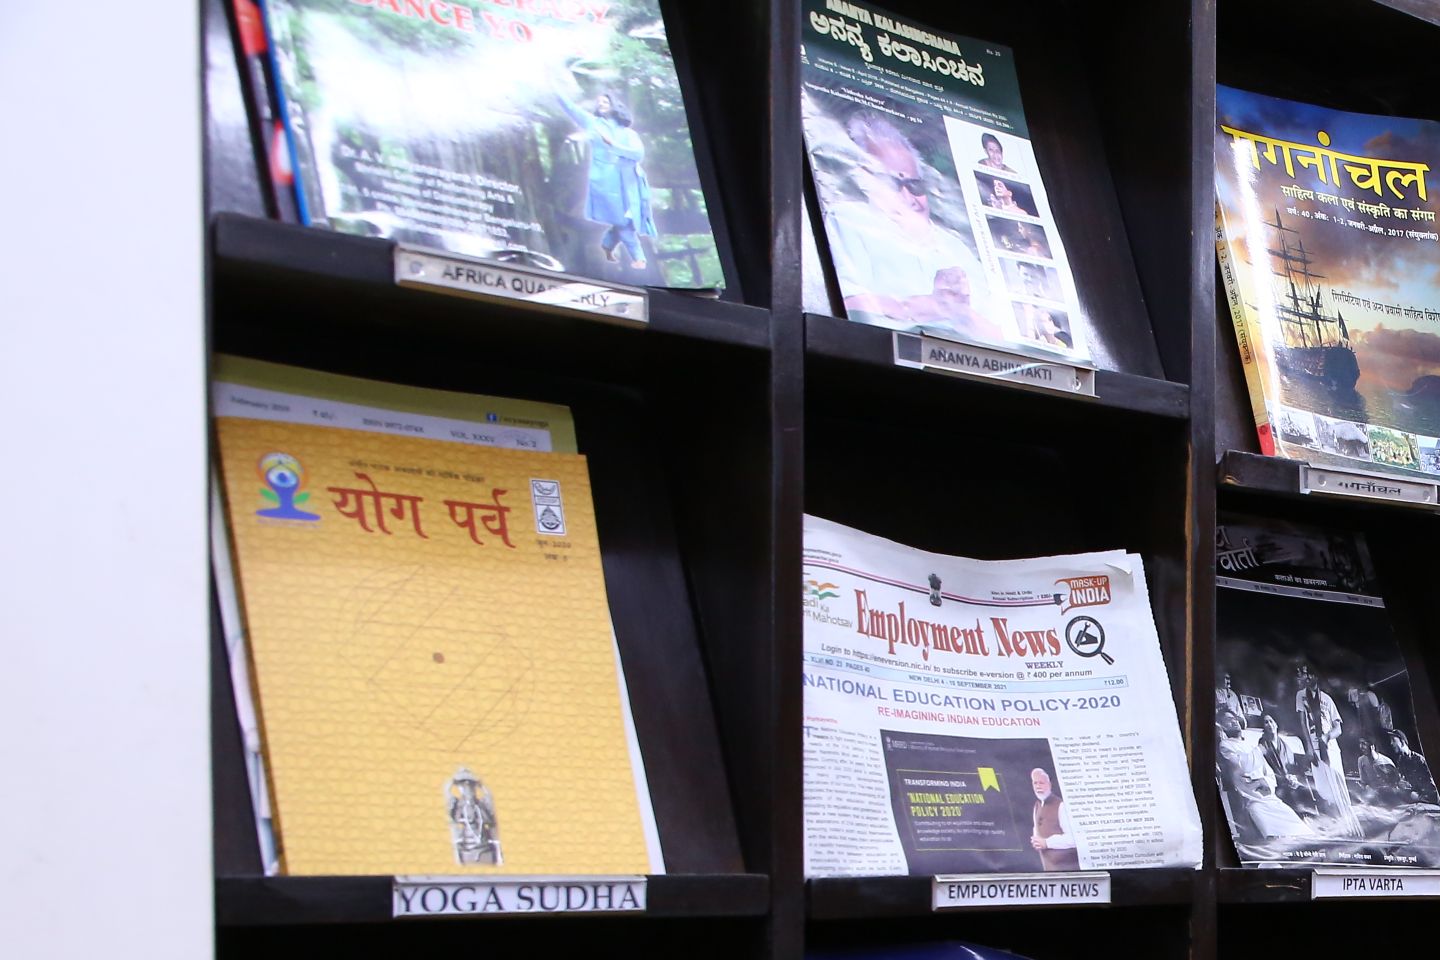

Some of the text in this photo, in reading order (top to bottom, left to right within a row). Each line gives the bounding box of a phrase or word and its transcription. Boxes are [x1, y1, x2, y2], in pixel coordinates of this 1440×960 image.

[809, 10, 873, 63] ಅನನ್ಯ
[1220, 124, 1430, 202] गगनांचल
[1281, 184, 1435, 223] साहित्य कला एवं संस्कृति का संगम
[1388, 228, 1404, 238] 2017
[442, 265, 506, 289] AFRICA
[929, 347, 980, 370] ANANYA
[327, 471, 517, 549] योग पर्व
[1216, 538, 1259, 573] वार्ता
[1070, 576, 1108, 589] MASK-UP
[1072, 585, 1110, 605] INDIA
[853, 588, 1061, 662] Employment News
[821, 643, 842, 655] Login
[844, 647, 852, 656] to
[933, 665, 941, 673] to
[942, 667, 978, 677] subscribe
[979, 671, 1014, 679] e-version
[1016, 671, 1025, 681] @
[1033, 670, 1047, 678] 400
[1049, 671, 1062, 679] per
[1065, 669, 1093, 677] annum
[1025, 660, 1064, 670] WEEKLY
[803, 672, 1121, 713] NATIONAL EDUCATION POLICY-2020
[877, 706, 1041, 727] RE-IMAGINING INDIAN EDUCATION
[948, 881, 1099, 900] EMPLOYEMENT NEWS
[1343, 877, 1404, 891] IPTA VARTA
[397, 883, 642, 913] YOGA SUDHA
